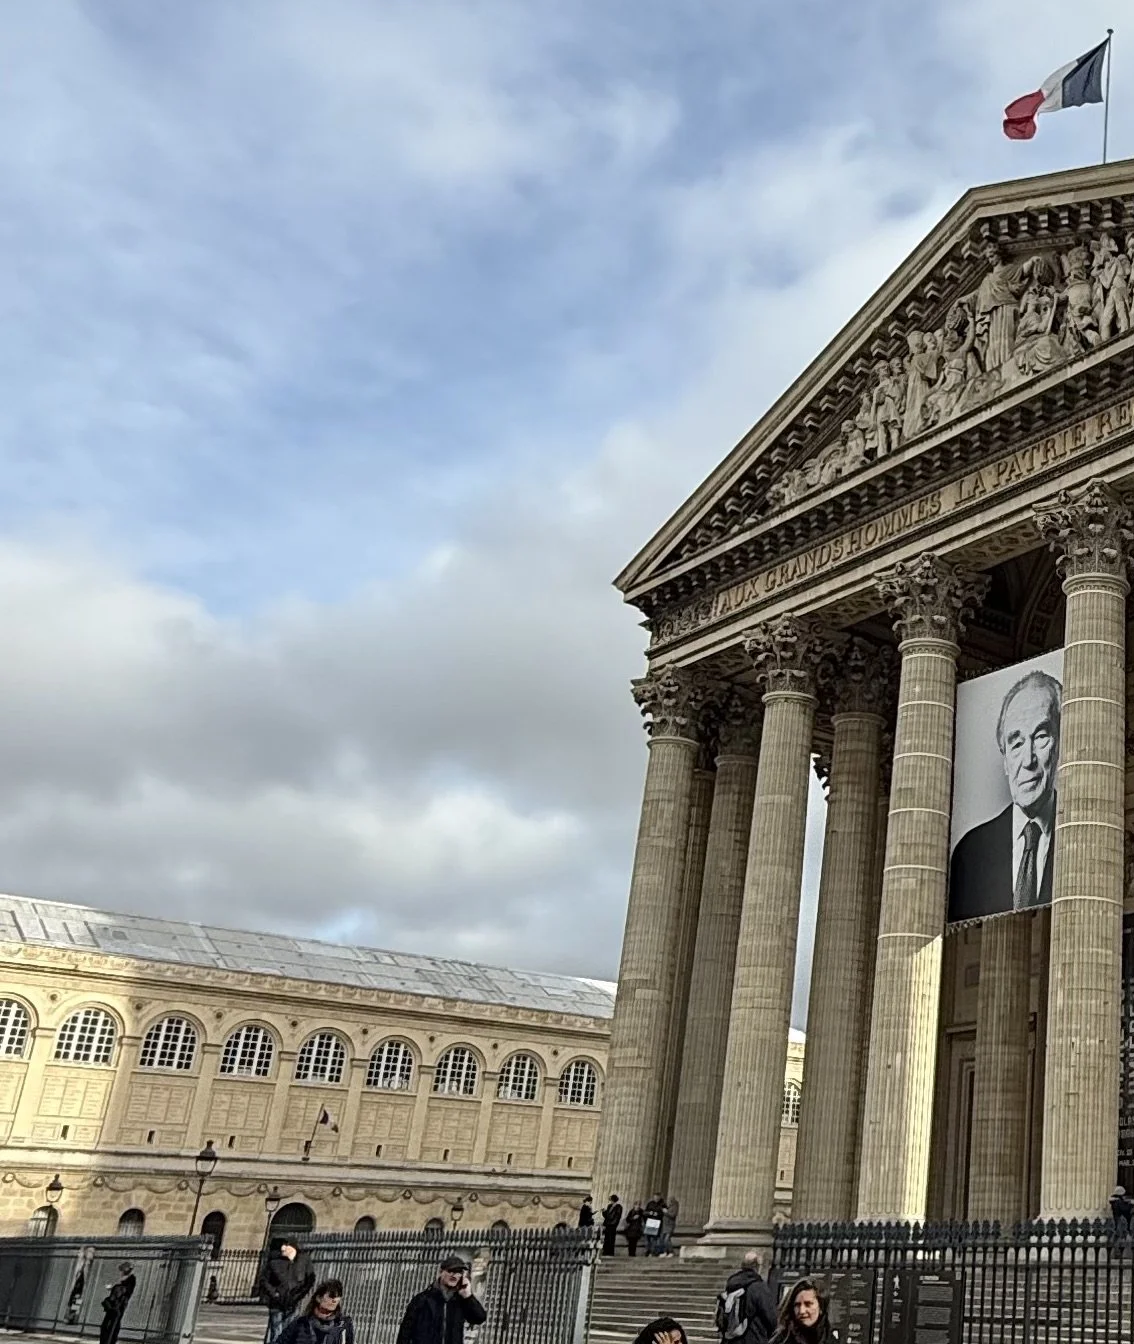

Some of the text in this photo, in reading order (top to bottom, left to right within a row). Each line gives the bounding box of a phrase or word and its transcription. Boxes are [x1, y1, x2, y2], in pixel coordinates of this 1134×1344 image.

[720, 578, 760, 615] AUX
[764, 538, 844, 592] GRANDS
[846, 492, 943, 555] HOMMES
[955, 471, 988, 505] LA
[992, 422, 1087, 488] PATRIE
